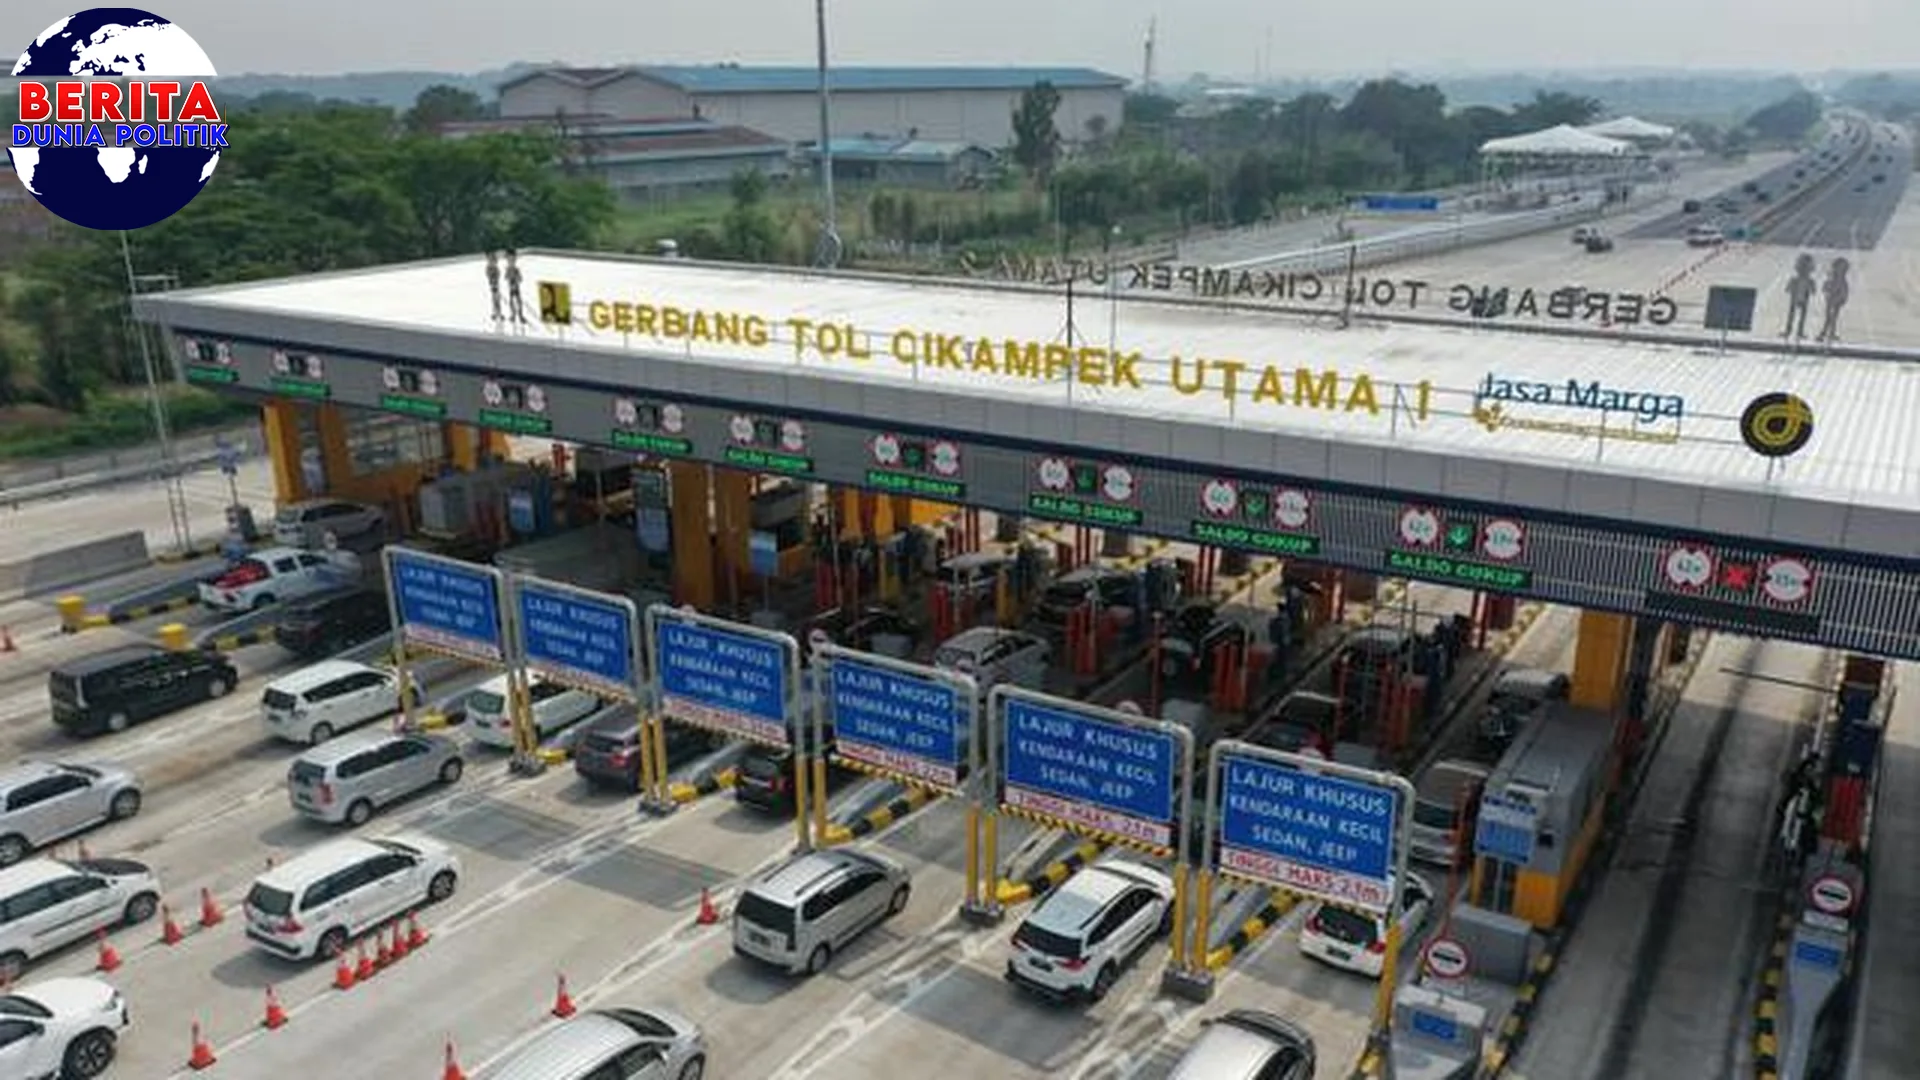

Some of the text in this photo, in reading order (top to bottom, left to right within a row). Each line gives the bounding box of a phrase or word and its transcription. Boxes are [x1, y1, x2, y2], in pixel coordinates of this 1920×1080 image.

[588, 300, 768, 347] GERBANG
[787, 317, 871, 360] TOL
[891, 330, 1141, 389] CIKAMPEK
[1171, 355, 1380, 416] UTAMA
[1477, 372, 1684, 423] Jasa Marga
[1391, 552, 1451, 574] SALDO
[1018, 713, 1158, 762] LAJUR KHUSUS
[1018, 739, 1109, 773] KENDARAAN
[1101, 781, 1136, 799] JEEP
[1231, 766, 1387, 817] LAJUR KHUSUS
[1230, 794, 1384, 846] KENDARAAN KECIL
[1318, 840, 1358, 861] JEEP
